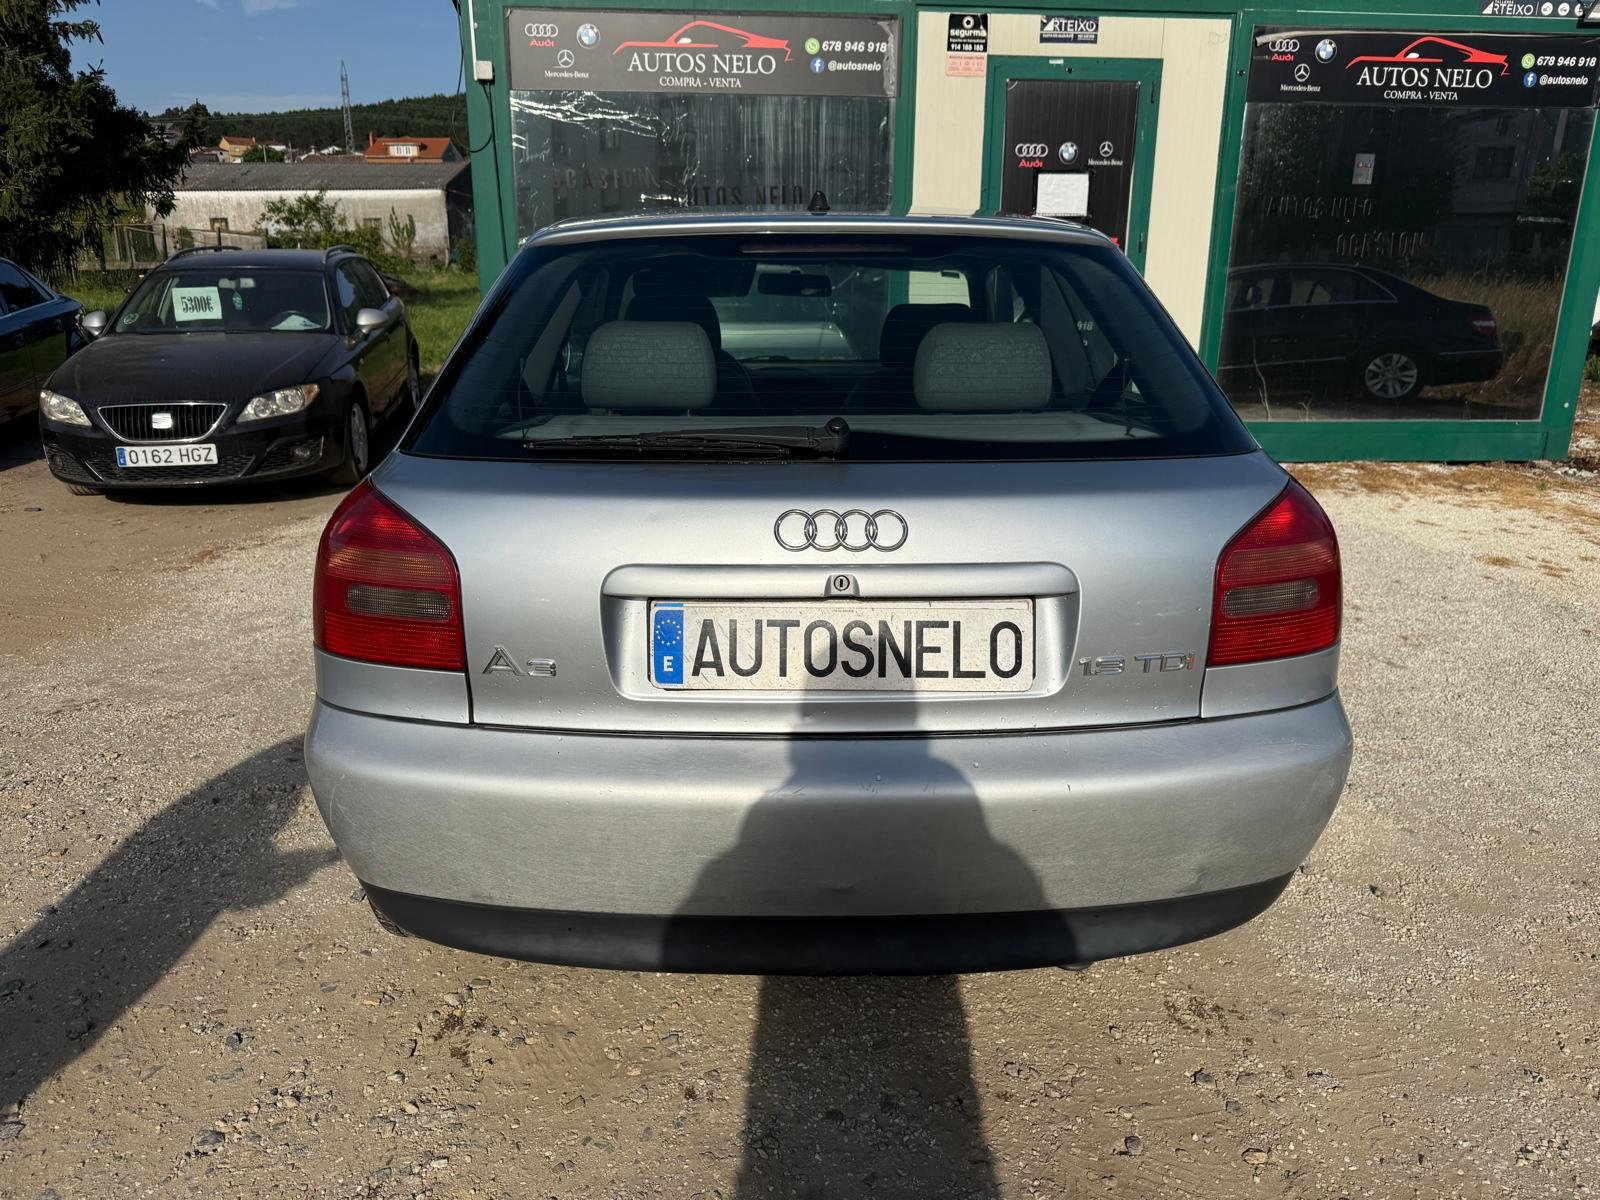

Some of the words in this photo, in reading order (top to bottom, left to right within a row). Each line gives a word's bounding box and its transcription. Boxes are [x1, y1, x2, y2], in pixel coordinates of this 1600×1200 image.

[530, 39, 555, 47] Audi
[822, 41, 842, 52] 678
[844, 41, 866, 52] 946
[867, 42, 888, 53] 918
[627, 52, 706, 73] AUTOS
[713, 54, 776, 74] NELO
[1271, 53, 1294, 61] Audi
[1537, 56, 1556, 66] 678
[1557, 56, 1577, 67] 946
[1578, 56, 1597, 67] 918
[827, 60, 882, 72] @autosnelo
[544, 70, 590, 79] Mercedes-Benz
[1356, 66, 1430, 87] AUTOS
[1434, 68, 1493, 89] NELO
[1539, 74, 1589, 86] @autosnelo
[659, 76, 702, 87] COMPRA
[709, 78, 742, 88] VENTA
[1280, 84, 1321, 92] Mercedes-Benz
[1383, 90, 1422, 100] COMPRA
[1429, 91, 1458, 100] VENTA
[1019, 159, 1043, 168] Audi
[181, 296, 213, 313] 5300€
[128, 449, 173, 464] 0162
[179, 447, 214, 463] HGZ
[692, 619, 1023, 679] AUTOSNELO
[482, 646, 556, 677] A3
[663, 655, 674, 672] E
